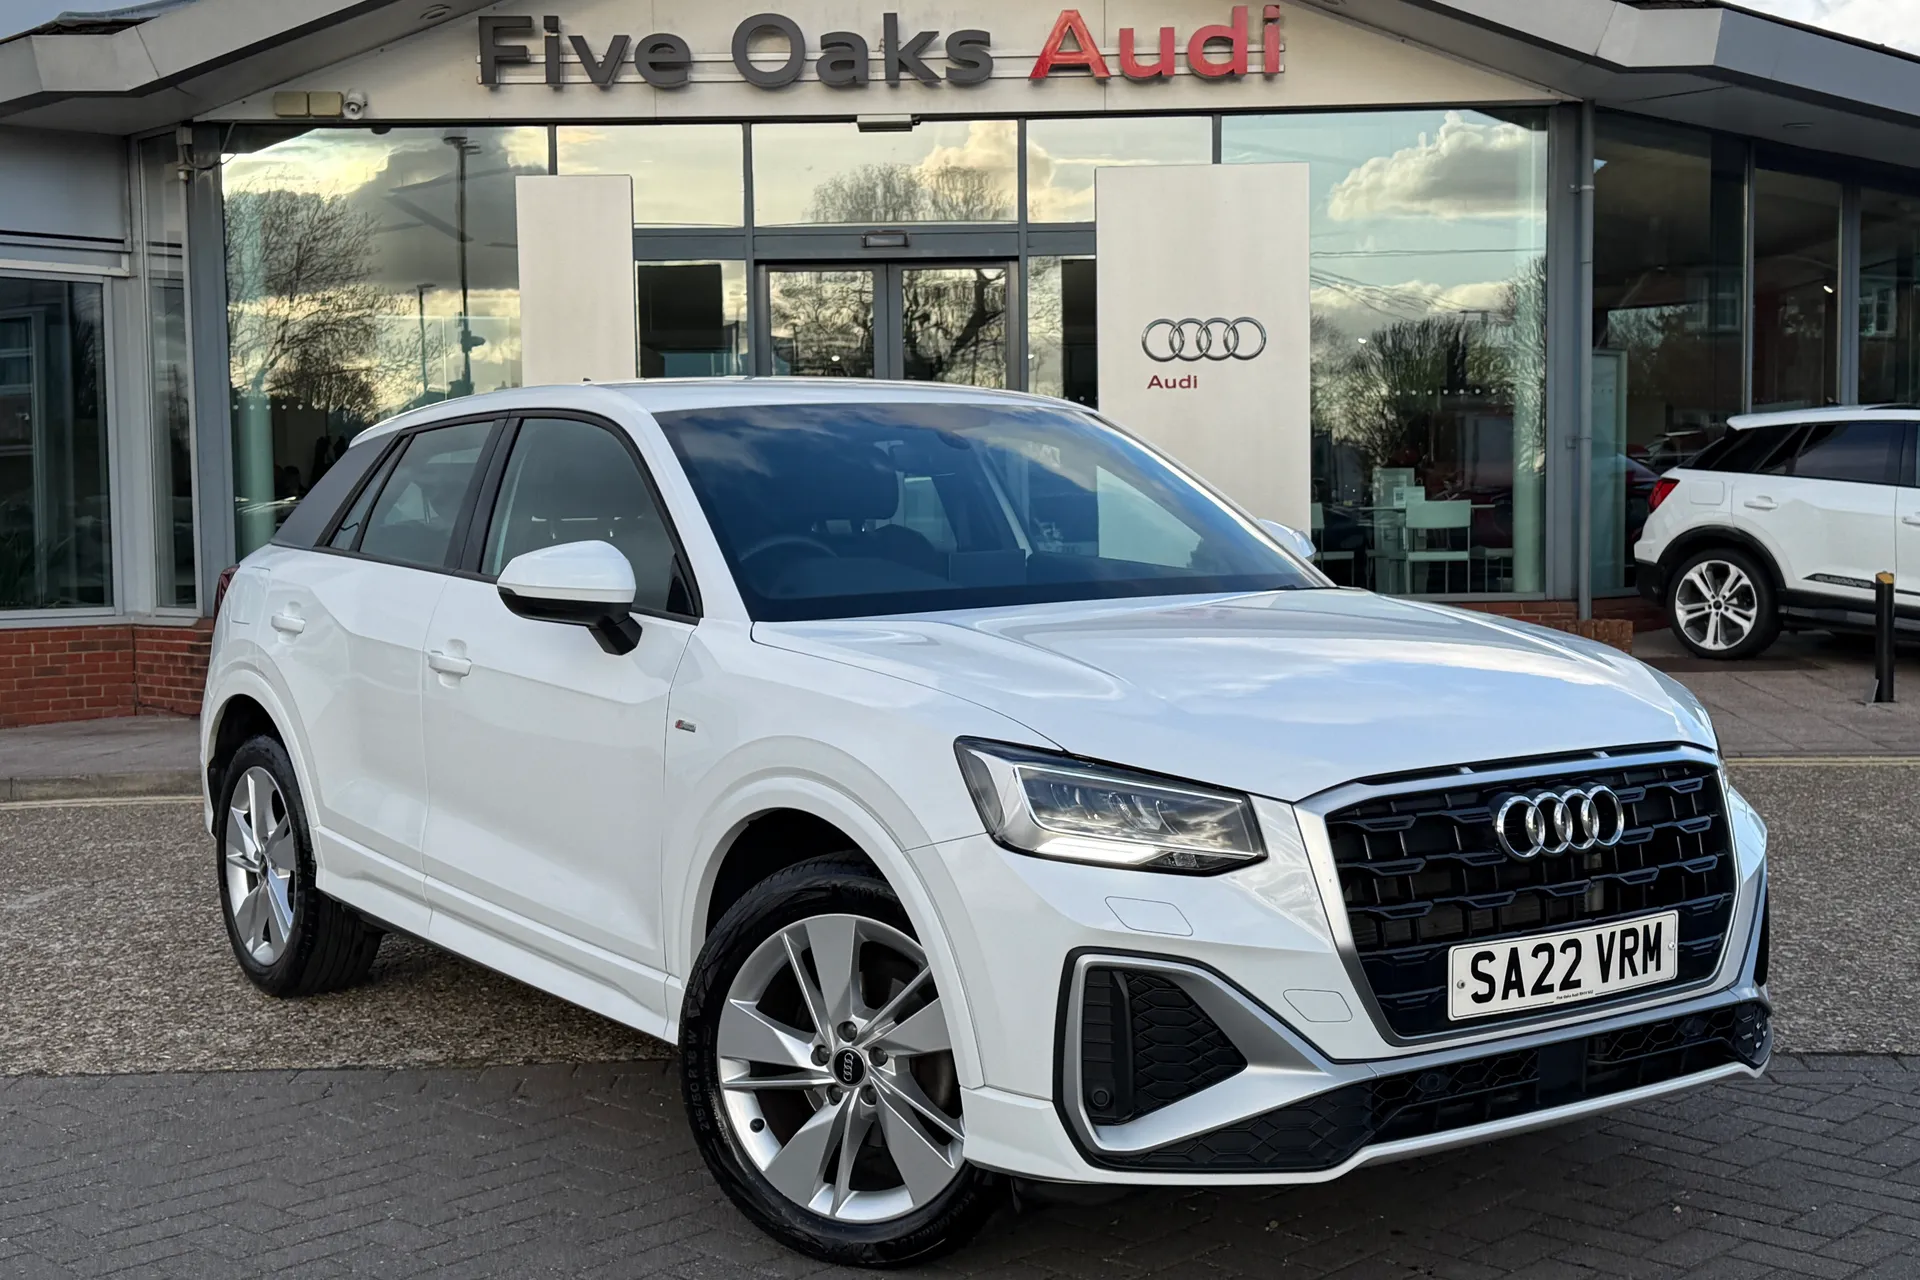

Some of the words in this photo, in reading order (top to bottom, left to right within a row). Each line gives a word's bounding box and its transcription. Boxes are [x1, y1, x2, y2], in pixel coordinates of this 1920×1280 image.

[478, 15, 692, 88] Five
[732, 13, 994, 87] Oaks
[1028, 5, 1281, 80] Audi
[1147, 374, 1198, 389] Audi
[1471, 939, 1582, 1004] SA22
[1596, 921, 1662, 983] VRM
